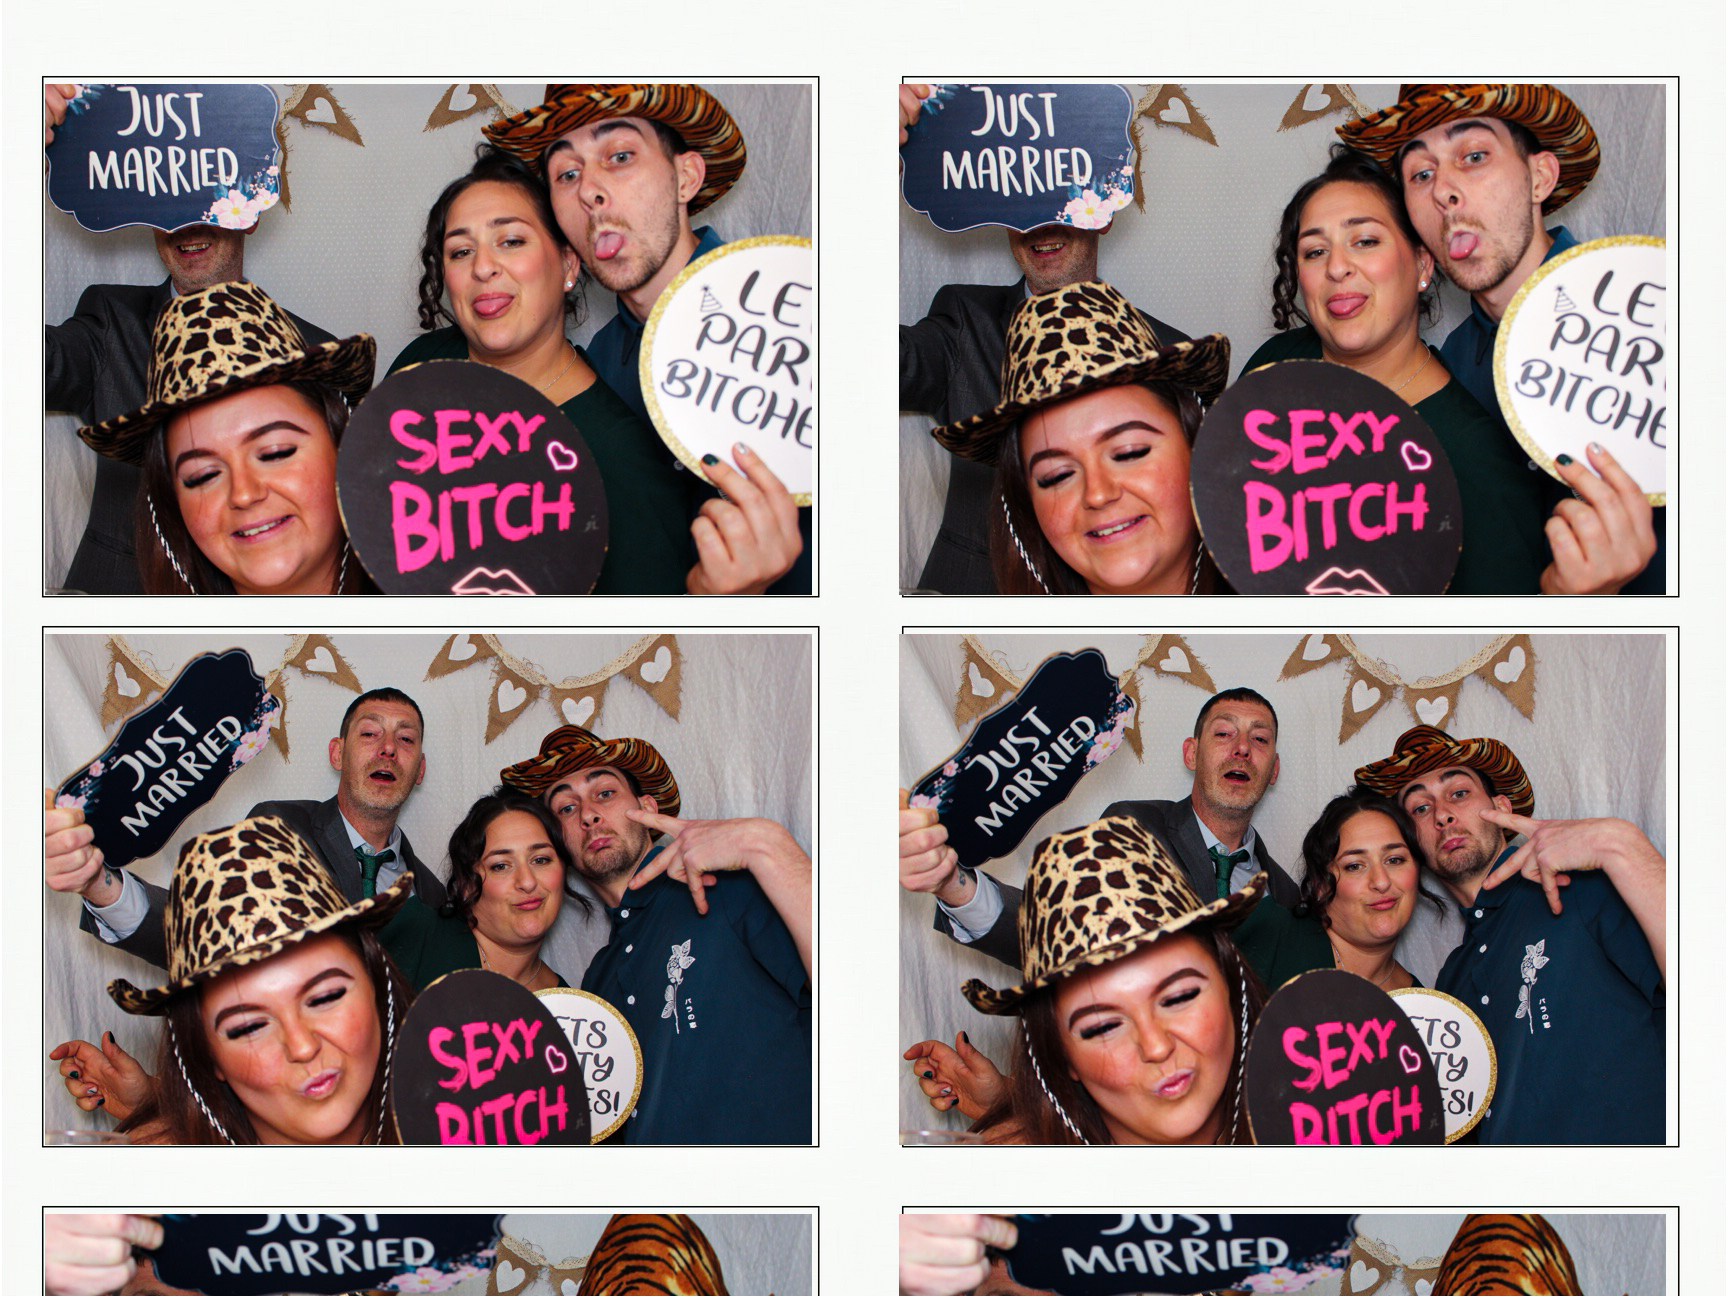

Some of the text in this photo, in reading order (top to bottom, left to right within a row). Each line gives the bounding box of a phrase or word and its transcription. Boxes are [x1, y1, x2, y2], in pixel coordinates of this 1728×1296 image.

[117, 86, 203, 140] JUST
[971, 86, 1057, 140] JUST
[89, 146, 239, 197] MARRIED
[943, 146, 1093, 197] MARRIED
[739, 270, 812, 327] LE
[1593, 270, 1666, 327] LE
[696, 313, 812, 386] PAR
[1550, 313, 1666, 386] PAR
[661, 359, 812, 449] BITCHE
[1515, 359, 1666, 449] BITCHE
[389, 409, 547, 474] SEXY
[1243, 409, 1401, 474] SEXY
[389, 481, 576, 574] BITCH
[1243, 481, 1430, 574] BITCH
[111, 706, 198, 791] JUST
[121, 716, 242, 837] MARRIED
[965, 706, 1052, 791] JUST
[975, 716, 1096, 837] MARRIED
[428, 1017, 543, 1093] SEXY
[1282, 1017, 1397, 1093] SEXY
[207, 1237, 435, 1276] MARRIED
[1061, 1237, 1289, 1276] MARRIED
